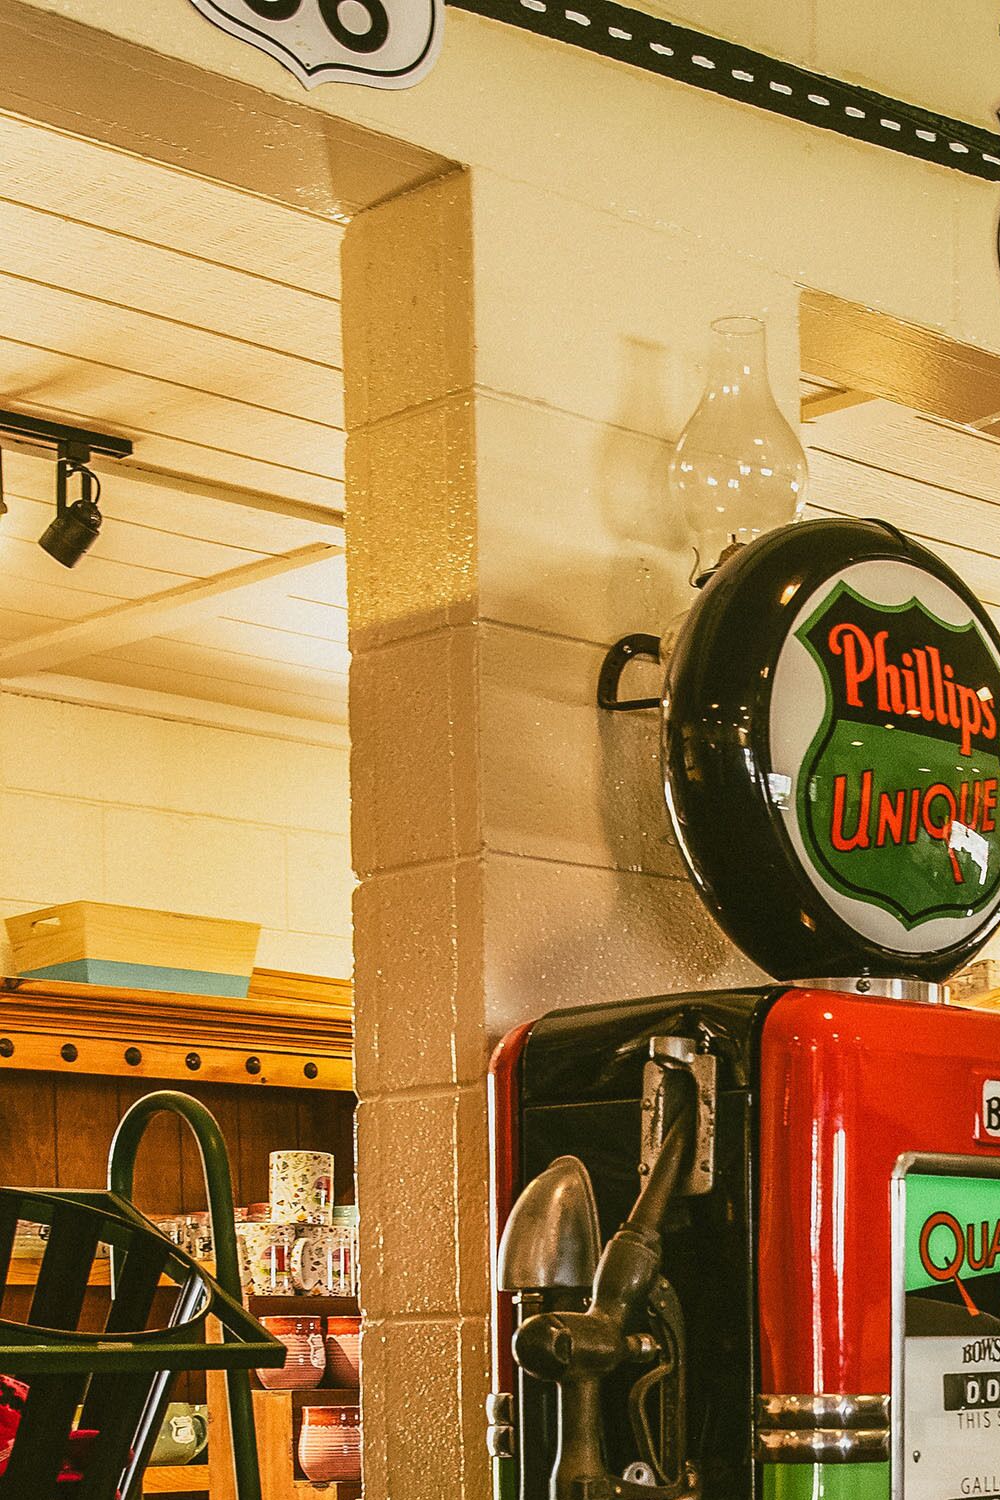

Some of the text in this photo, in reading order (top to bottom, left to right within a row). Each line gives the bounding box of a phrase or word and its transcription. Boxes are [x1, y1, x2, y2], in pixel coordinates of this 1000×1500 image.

[828, 622, 997, 757] Phillips
[830, 770, 998, 885] UNIQUE
[957, 1410, 991, 1429] THIS
